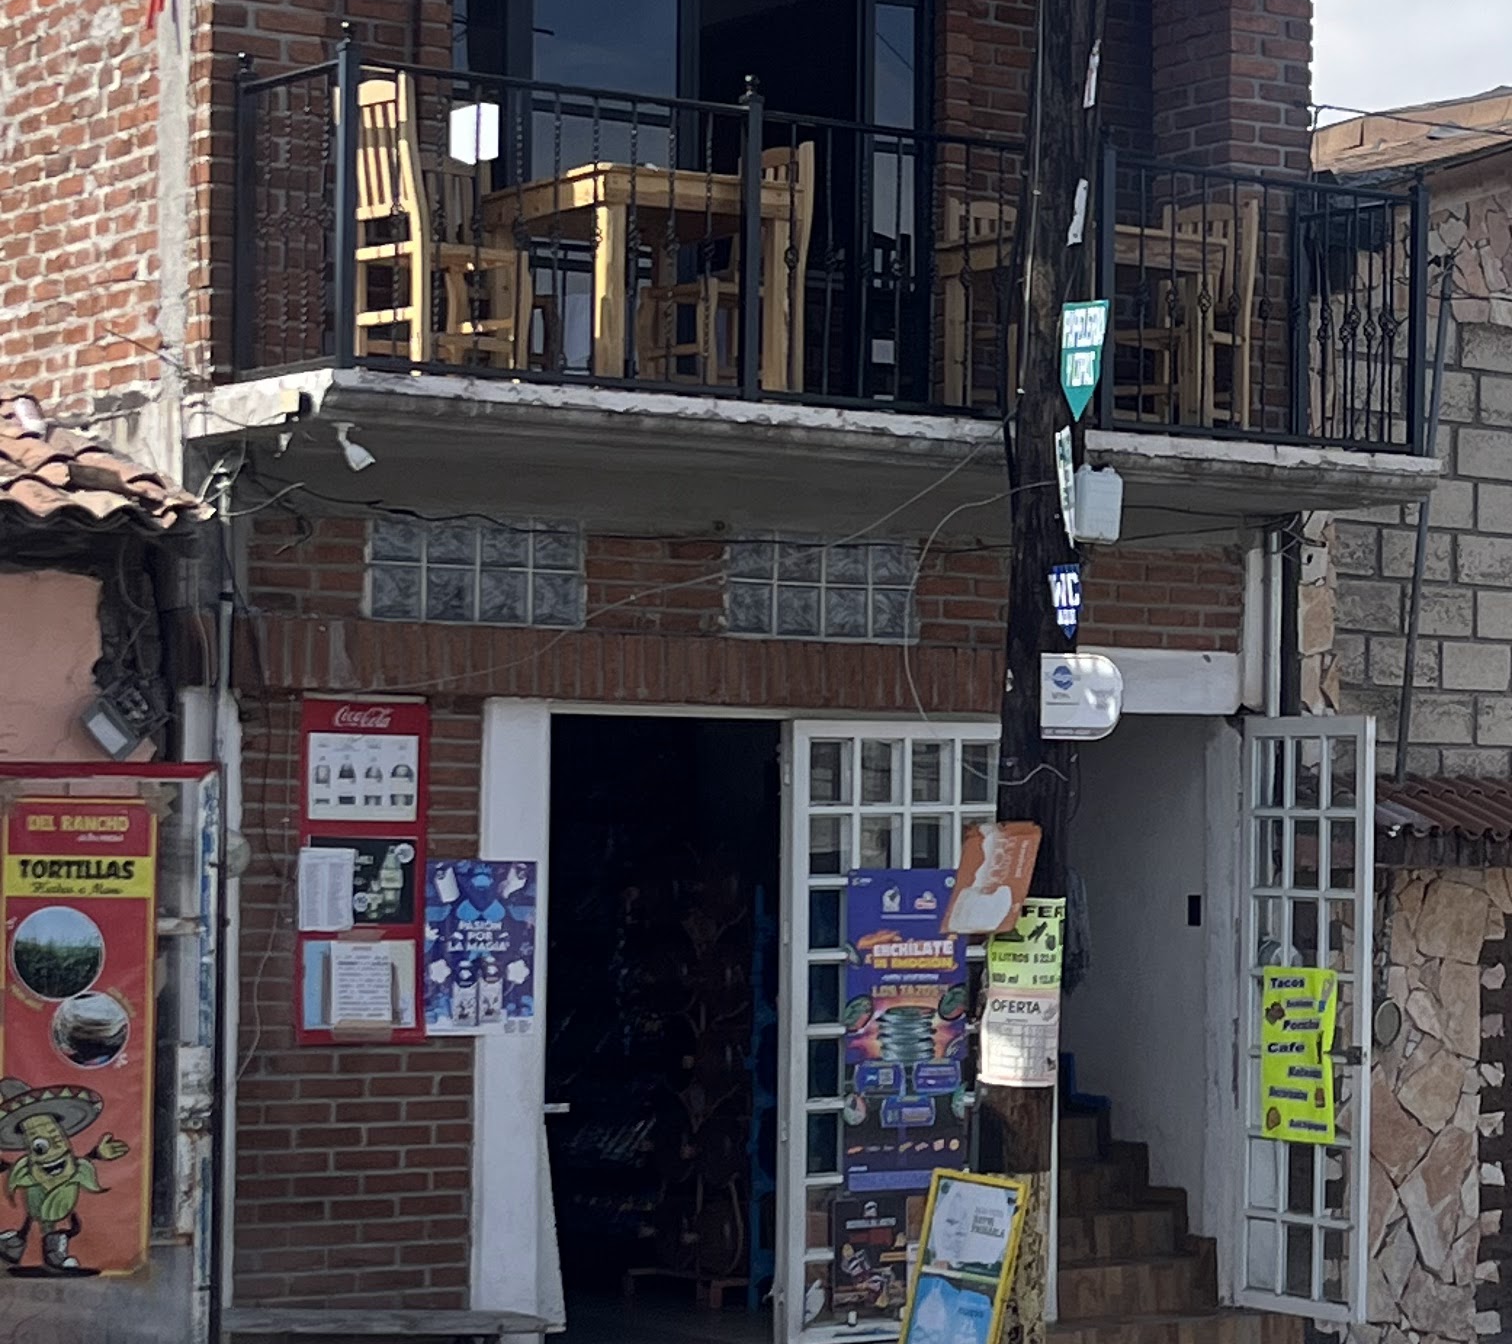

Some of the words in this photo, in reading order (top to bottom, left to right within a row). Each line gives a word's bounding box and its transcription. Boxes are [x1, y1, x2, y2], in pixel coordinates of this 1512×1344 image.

[1048, 572, 1080, 607] WC
[60, 814, 130, 832] RANCHO
[19, 859, 135, 879] TORTILLAS
[467, 931, 494, 941] POR
[448, 941, 463, 952] LA
[1270, 977, 1305, 989] Tacos
[991, 999, 1042, 1014] OFERTA
